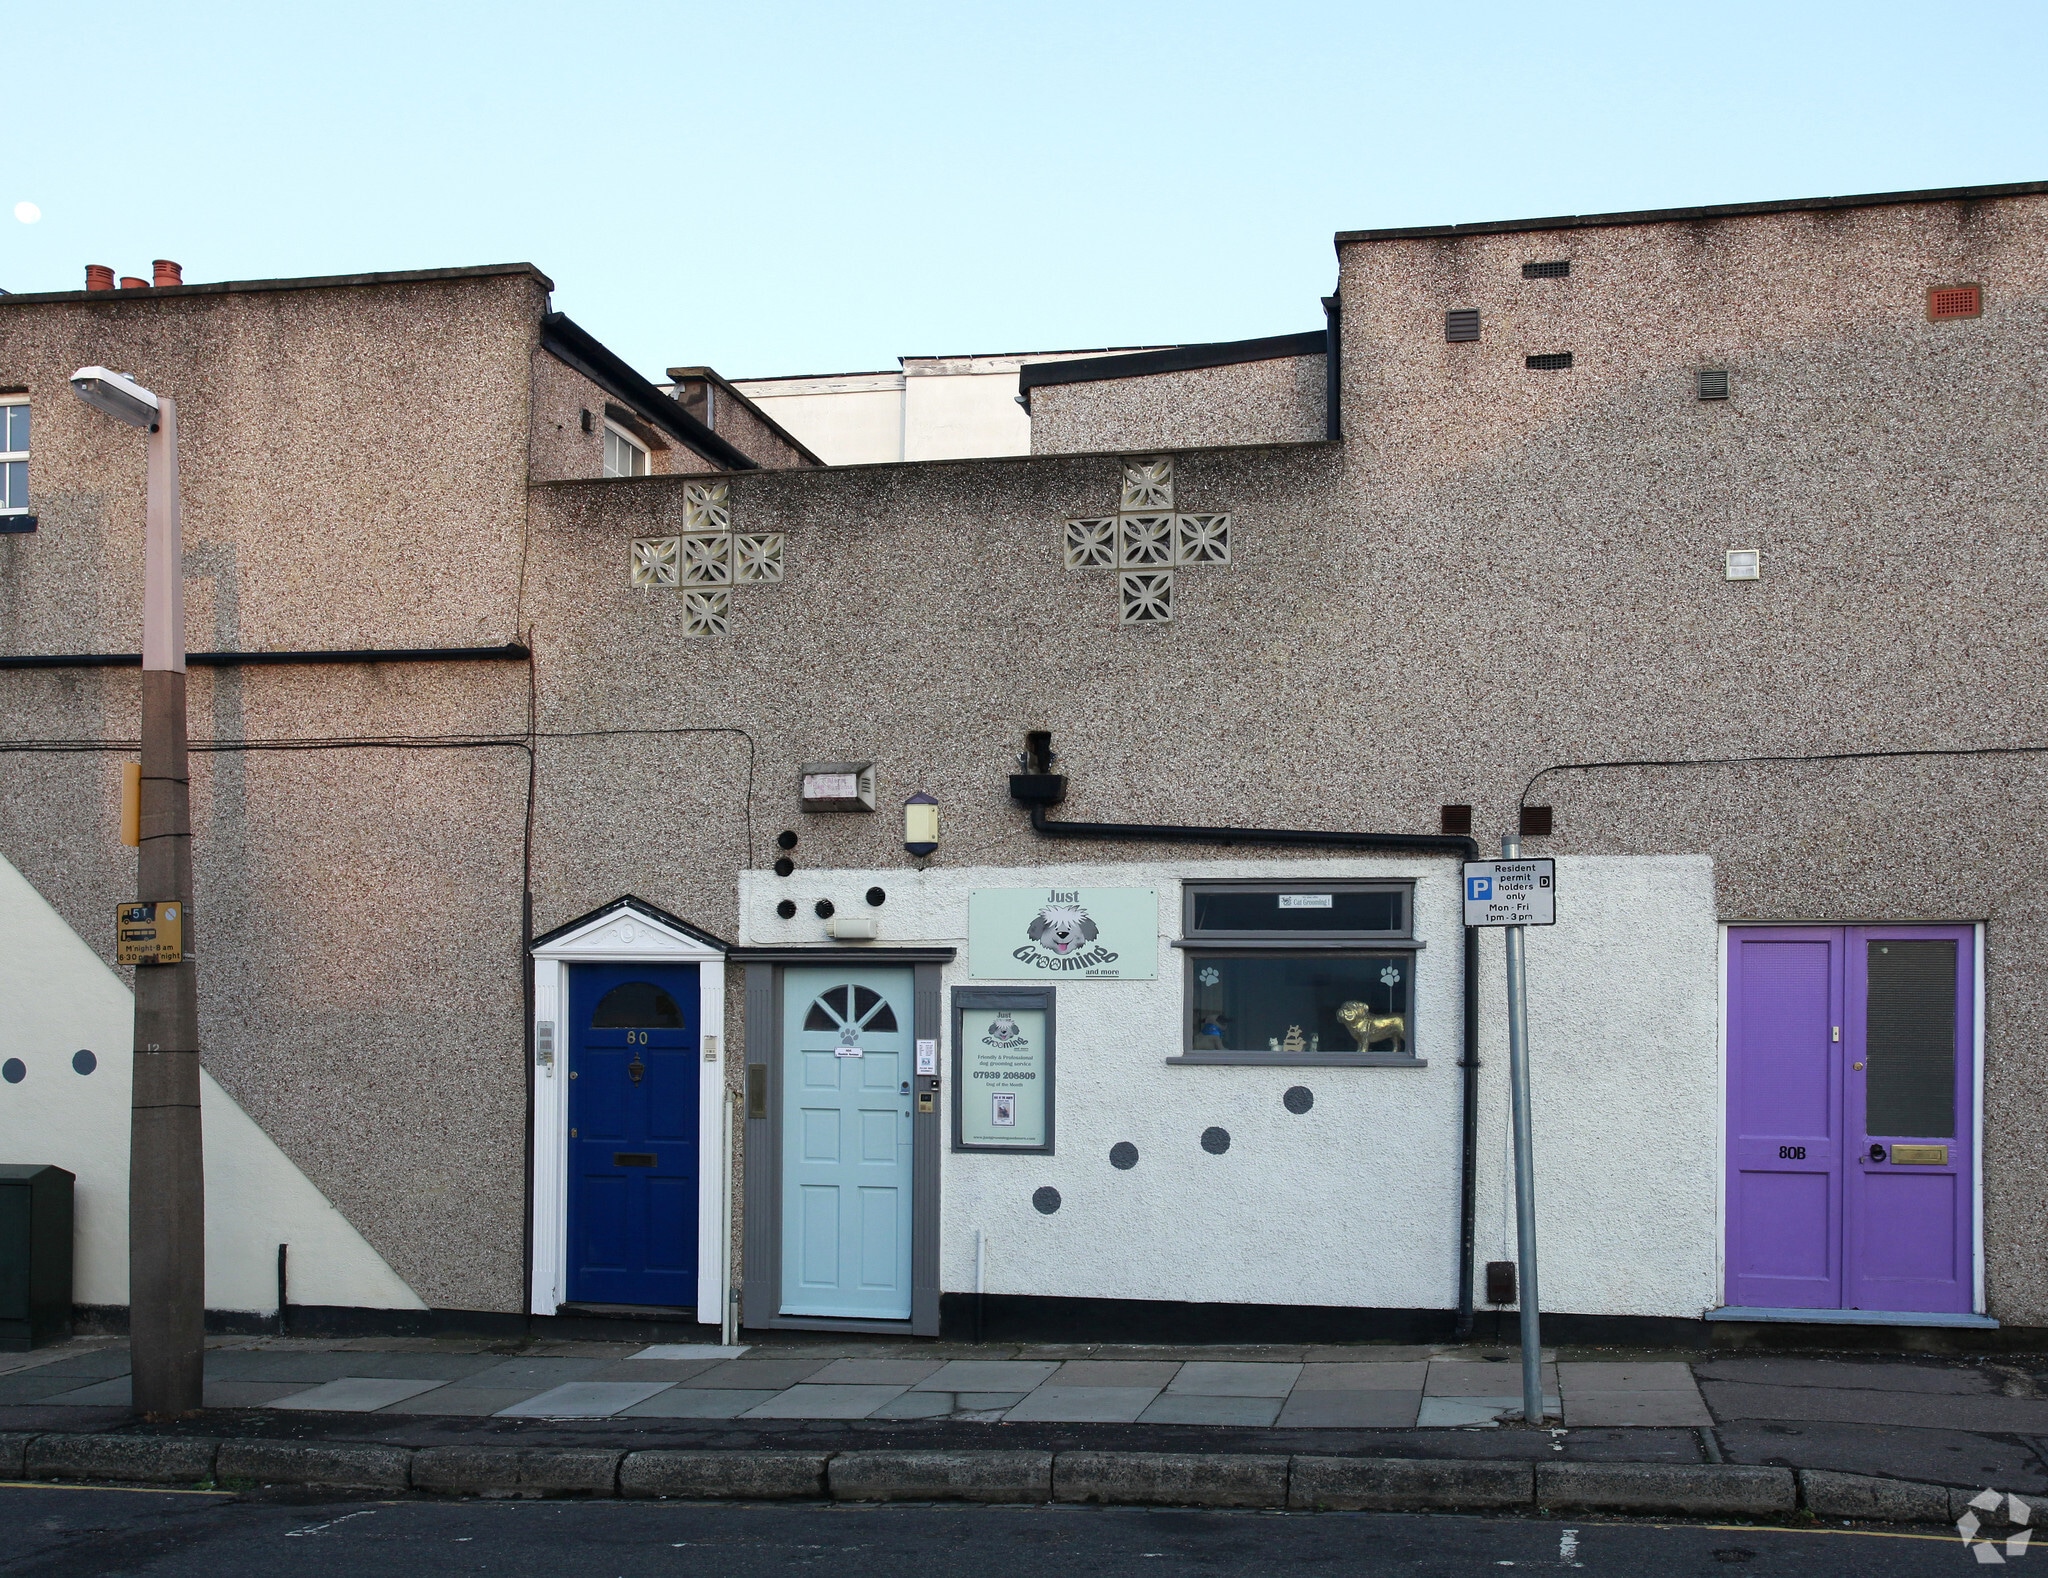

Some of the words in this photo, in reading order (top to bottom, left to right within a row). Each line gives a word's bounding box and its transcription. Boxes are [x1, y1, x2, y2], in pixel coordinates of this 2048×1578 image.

[1495, 864, 1536, 873] Resident
[1500, 873, 1531, 883] permit
[1541, 878, 1549, 886] D
[1473, 879, 1489, 899] P
[1498, 883, 1534, 891] holders
[1047, 889, 1080, 903] Just
[1506, 892, 1526, 901] only
[1489, 904, 1509, 912] Mon
[1517, 903, 1529, 911] Fri
[1012, 945, 1119, 971] Grooming
[996, 1011, 1012, 1019] Just
[626, 1030, 648, 1045] 80
[981, 1036, 1029, 1049] Grooming
[147, 1043, 160, 1055] 12
[973, 1071, 1001, 1079] 07939
[1779, 1145, 1806, 1160] 80B
